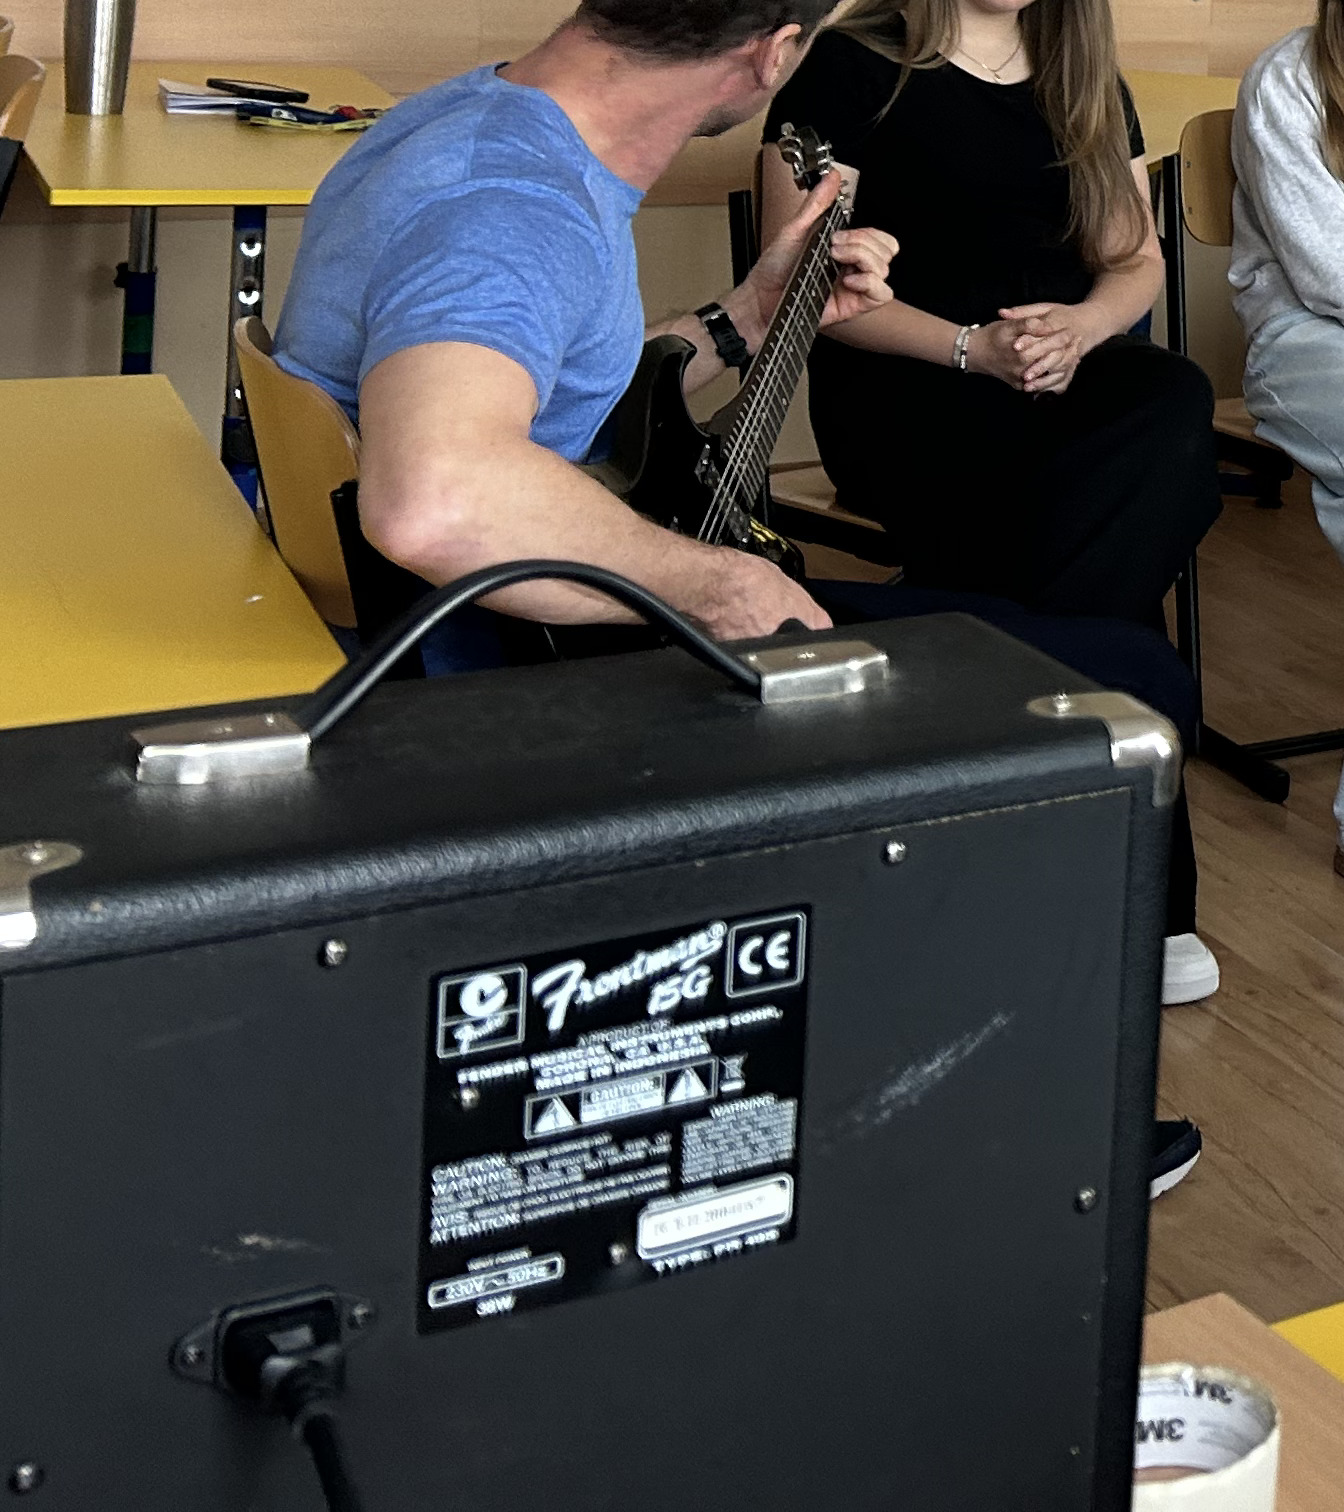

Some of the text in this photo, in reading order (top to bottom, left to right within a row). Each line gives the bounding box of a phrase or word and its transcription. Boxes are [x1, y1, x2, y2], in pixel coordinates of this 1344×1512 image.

[648, 964, 714, 1016] 15G
[456, 1056, 528, 1084] FENDER
[530, 1040, 605, 1069] MUSICAL
[610, 1017, 727, 1053] INSTRUMENTS
[535, 1068, 588, 1091] MADE
[614, 1043, 710, 1074] INDONESIA
[429, 1210, 520, 1244] ATTENTION:
[1136, 1417, 1185, 1444] 3M
